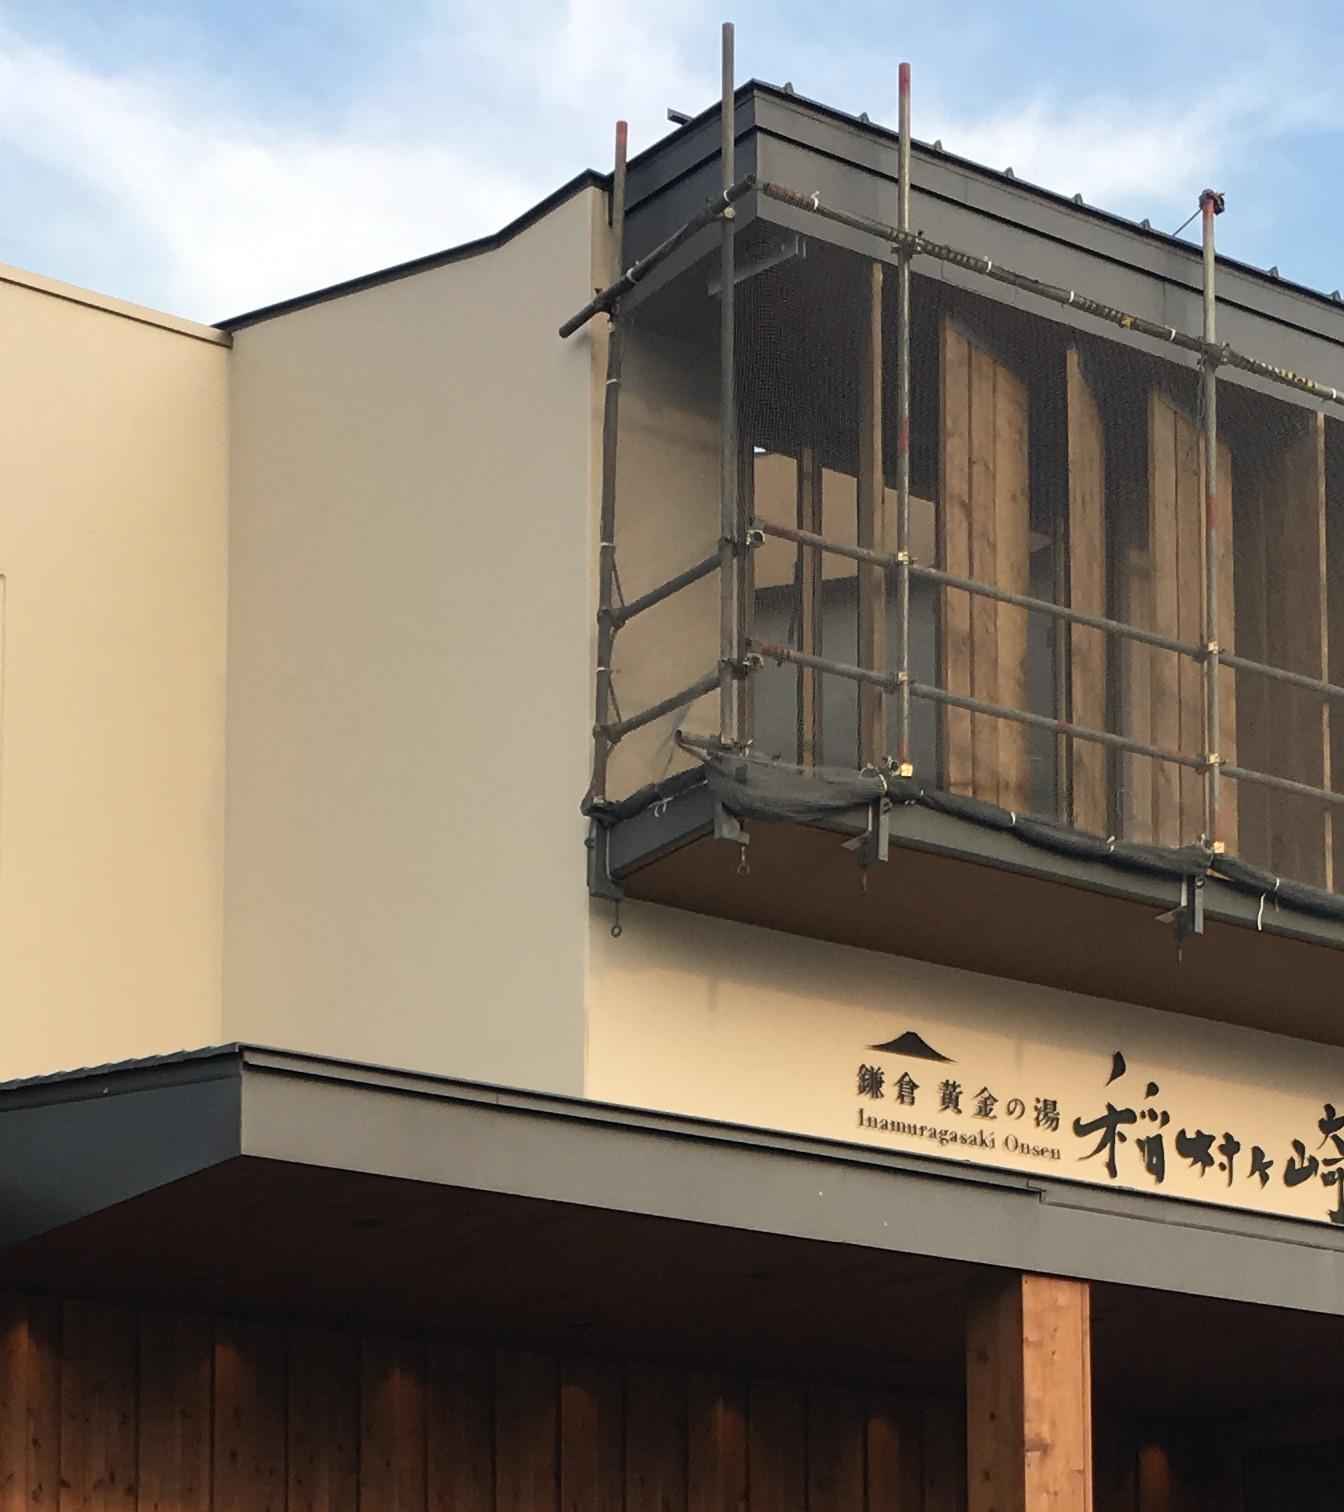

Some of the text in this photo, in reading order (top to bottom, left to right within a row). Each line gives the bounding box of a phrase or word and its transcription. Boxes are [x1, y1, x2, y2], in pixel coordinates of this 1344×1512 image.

[856, 1063, 1061, 1132] 鎌倉 黄金の湯
[857, 1107, 1062, 1160] Inamuragasaki Onsen
